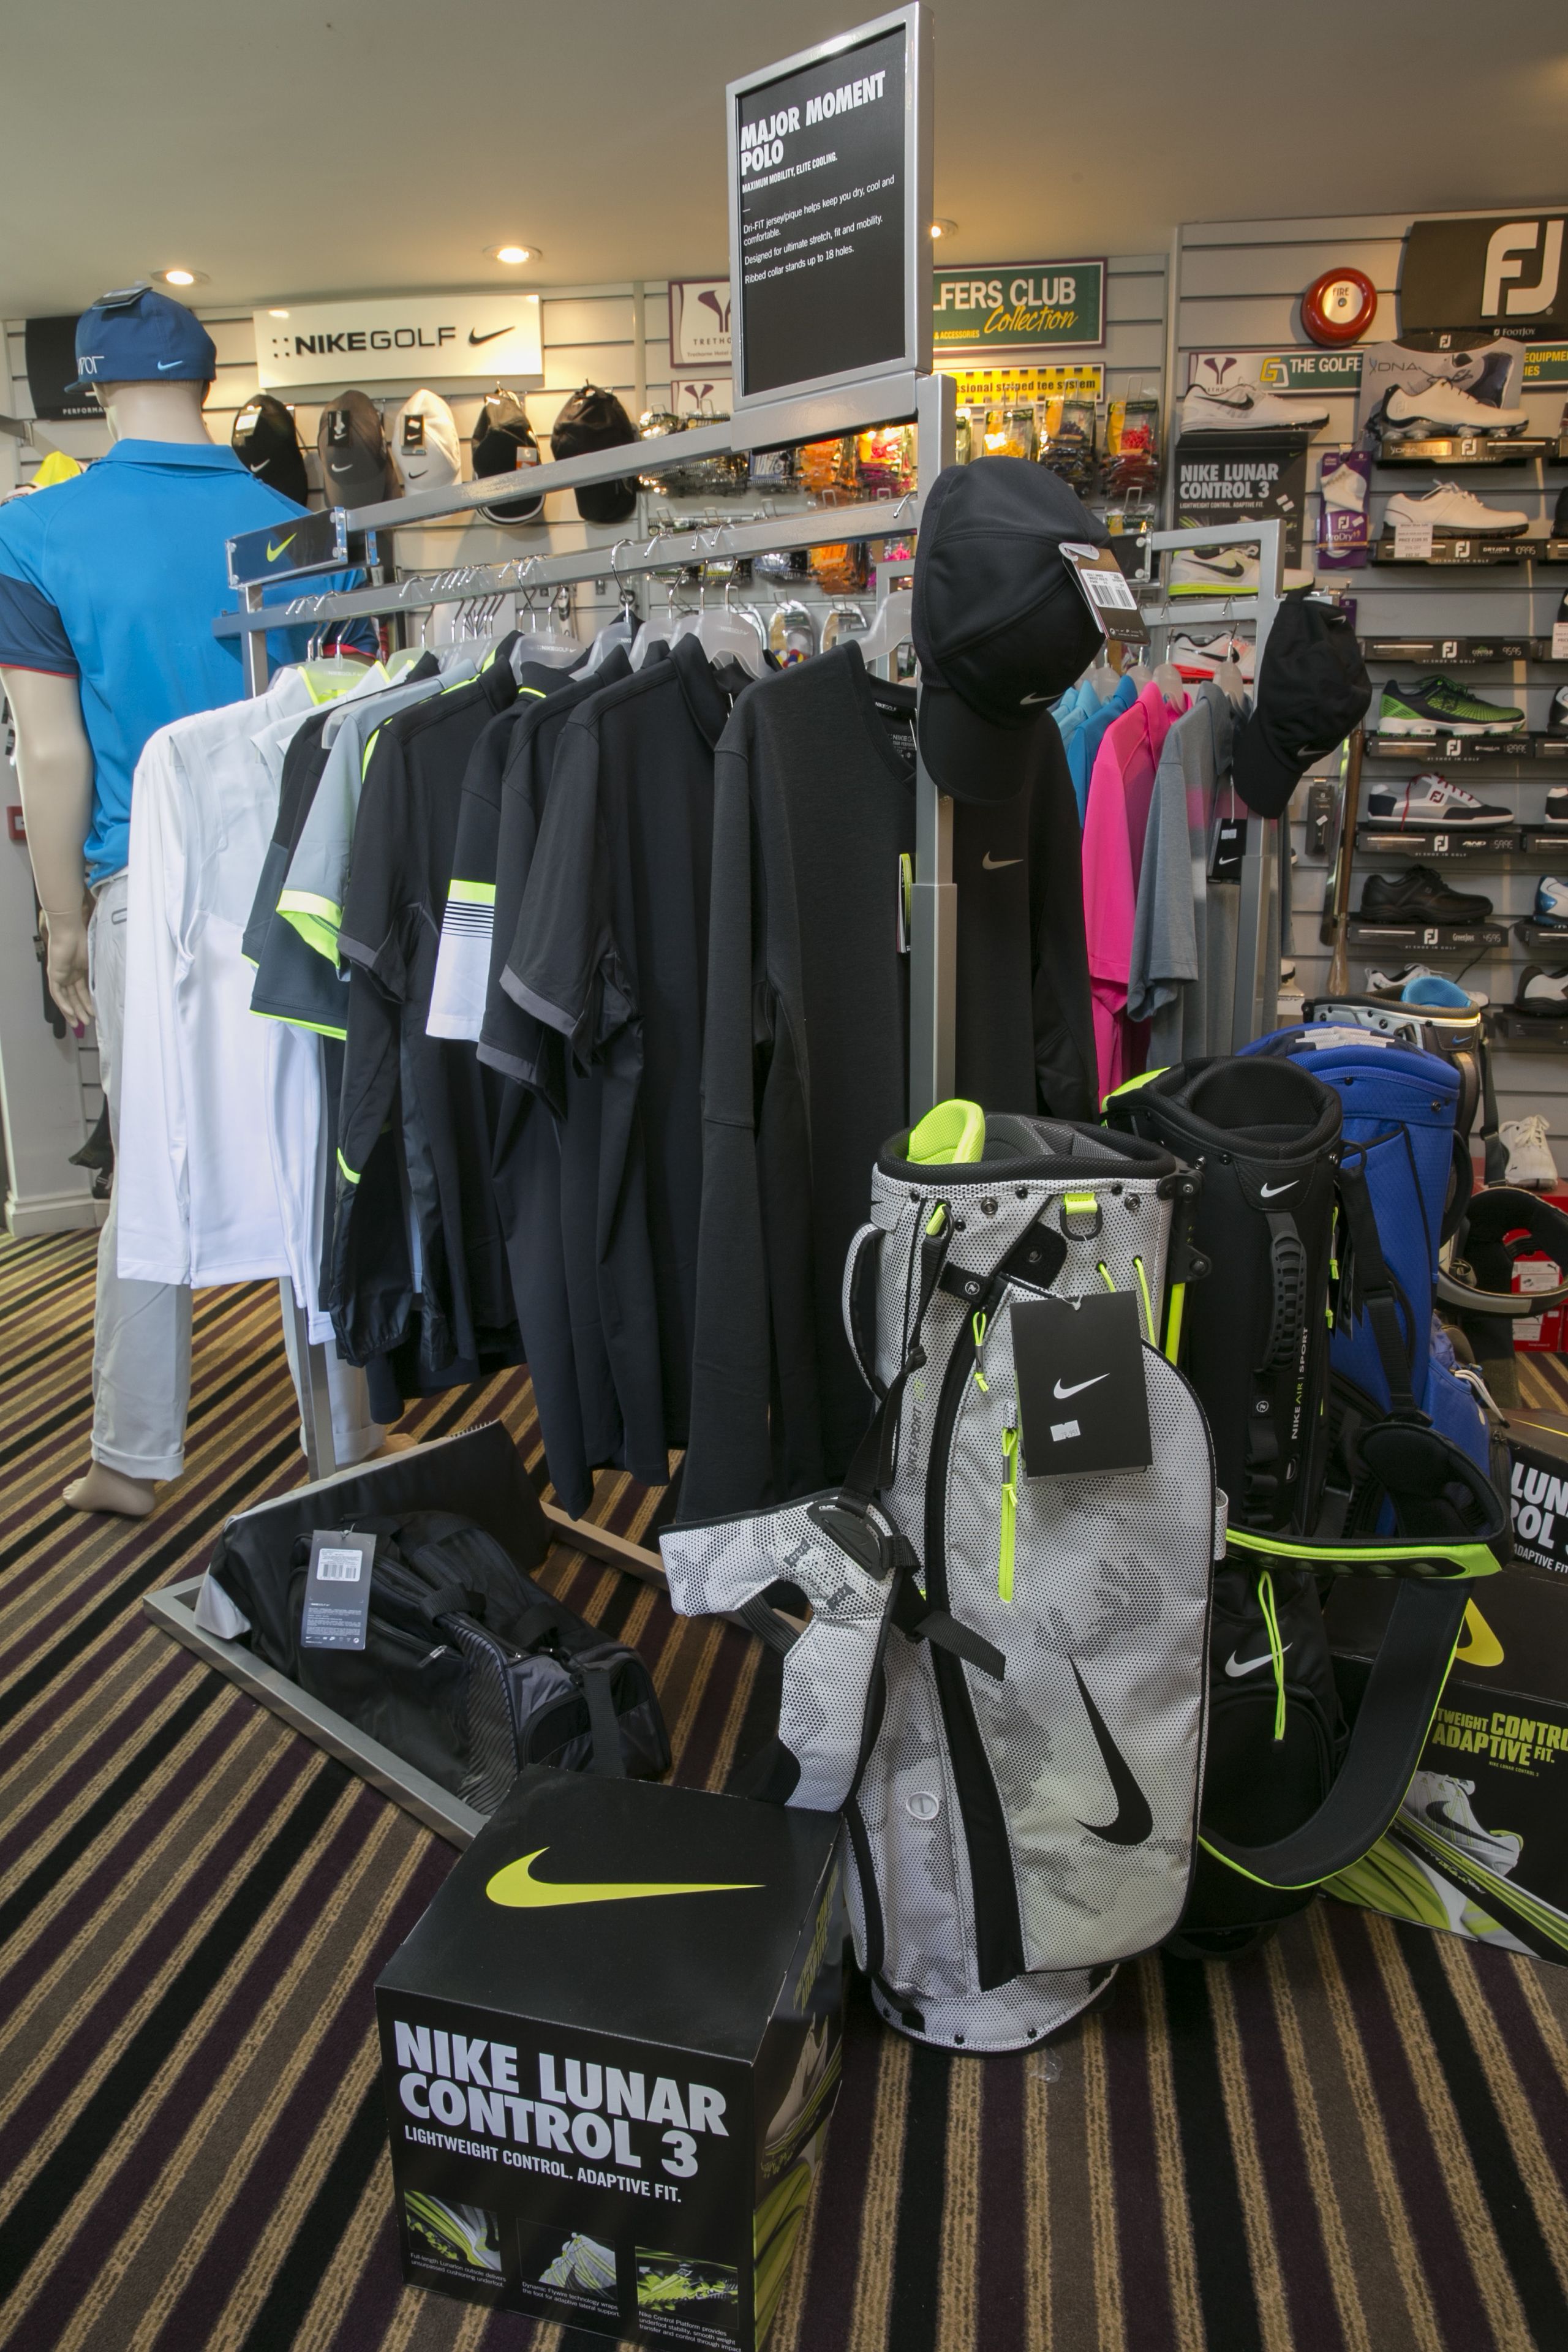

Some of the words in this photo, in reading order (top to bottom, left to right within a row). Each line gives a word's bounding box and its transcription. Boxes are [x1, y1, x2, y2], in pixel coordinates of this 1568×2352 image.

[741, 107, 801, 151] MAJOR
[806, 70, 886, 126] MOMENT
[741, 139, 783, 176] POLO
[742, 176, 768, 194] MAXIMUM
[769, 167, 795, 185] MOBILITY,
[796, 162, 811, 175] ELITE
[812, 152, 838, 168] COOLING.
[744, 219, 764, 235] Dri-FIT
[766, 208, 802, 228] jersey/pique
[804, 202, 821, 215] helps
[822, 196, 838, 208] keep
[839, 192, 851, 204] you
[853, 186, 865, 198] dry,
[867, 180, 880, 192] cool
[882, 174, 894, 187] and
[744, 228, 781, 246] comfortable.
[745, 249, 772, 266] Designed
[783, 239, 808, 253] ultimate
[809, 231, 832, 245] stretch,
[842, 224, 854, 235] and
[856, 214, 883, 230] mobility.
[745, 271, 766, 284] Ribbed
[767, 266, 784, 277] collar
[785, 258, 805, 272] stands
[807, 258, 816, 267] up
[817, 254, 824, 263] to
[825, 249, 834, 260] 18
[835, 244, 854, 257] holes.
[1480, 219, 1564, 317] FJ
[1009, 277, 1076, 307] CLUB
[1333, 287, 1349, 296] FIRE
[984, 304, 1078, 334] Collection
[295, 326, 456, 355] NIKEGOLF
[934, 331, 940, 340] &
[940, 330, 979, 339] ACCESSORIES
[1439, 334, 1451, 349] FJ
[1289, 358, 1315, 373] THE
[1524, 350, 1568, 363] EQUIPME
[1038, 381, 1054, 390] tee
[1057, 379, 1095, 392] system
[1461, 439, 1477, 455] FJ
[1180, 464, 1219, 482] NIKE
[1224, 463, 1279, 481] LUNAR
[1180, 481, 1253, 499] CONTROL
[1258, 481, 1270, 498] 3
[1338, 516, 1349, 529] FJ
[1455, 541, 1470, 557] FJ
[1442, 641, 1457, 658] FJ
[1446, 739, 1461, 756] FJ
[1429, 790, 1445, 803] FJ
[1434, 835, 1449, 851] FJ
[1424, 929, 1438, 944] FJ
[1291, 1406, 1300, 1439] NIKE
[1299, 1327, 1308, 1373] SPORT
[910, 1405, 922, 1449] SPORT
[906, 1447, 918, 1480] NIKE
[1511, 1461, 1568, 1518] LUN
[1432, 1722, 1532, 1766] ADAPTIVE
[1534, 1746, 1555, 1764] FIT.
[1515, 1766, 1534, 1776] CONTROL
[394, 2020, 519, 2094] NIKE
[538, 2052, 729, 2138] LUNAR
[399, 2072, 641, 2168] CONTROL
[662, 2129, 698, 2178] 3
[404, 2124, 499, 2162] LIGHTWEIGHT
[503, 2148, 574, 2180] CONTROL.
[577, 2166, 650, 2197] ADAPTIVE
[654, 2184, 682, 2203] FIT.
[410, 2252, 438, 2264] Full-length
[464, 2267, 484, 2277] outsole
[485, 2272, 506, 2282] delivers
[411, 2260, 445, 2272] unsurpassed
[446, 2269, 475, 2281] cushioning
[477, 2277, 505, 2288] underfoot.
[522, 2282, 546, 2293] Dynamic
[548, 2288, 568, 2298] Flywire
[568, 2294, 599, 2306] technology
[601, 2302, 618, 2311] wraps
[554, 2296, 578, 2307] adaptive
[597, 2307, 620, 2317] support.
[639, 2318, 667, 2328] underfoot
[668, 2324, 692, 2335] stability,
[693, 2331, 715, 2340] smooth
[716, 2336, 735, 2346] weight
[639, 2324, 661, 2333] transfer
[675, 2332, 695, 2342] control
[697, 2337, 720, 2348] through
[721, 2343, 741, 2352] impact
[653, 2314, 674, 2324] Control
[676, 2319, 700, 2330] Platform
[702, 2326, 727, 2337] provides
